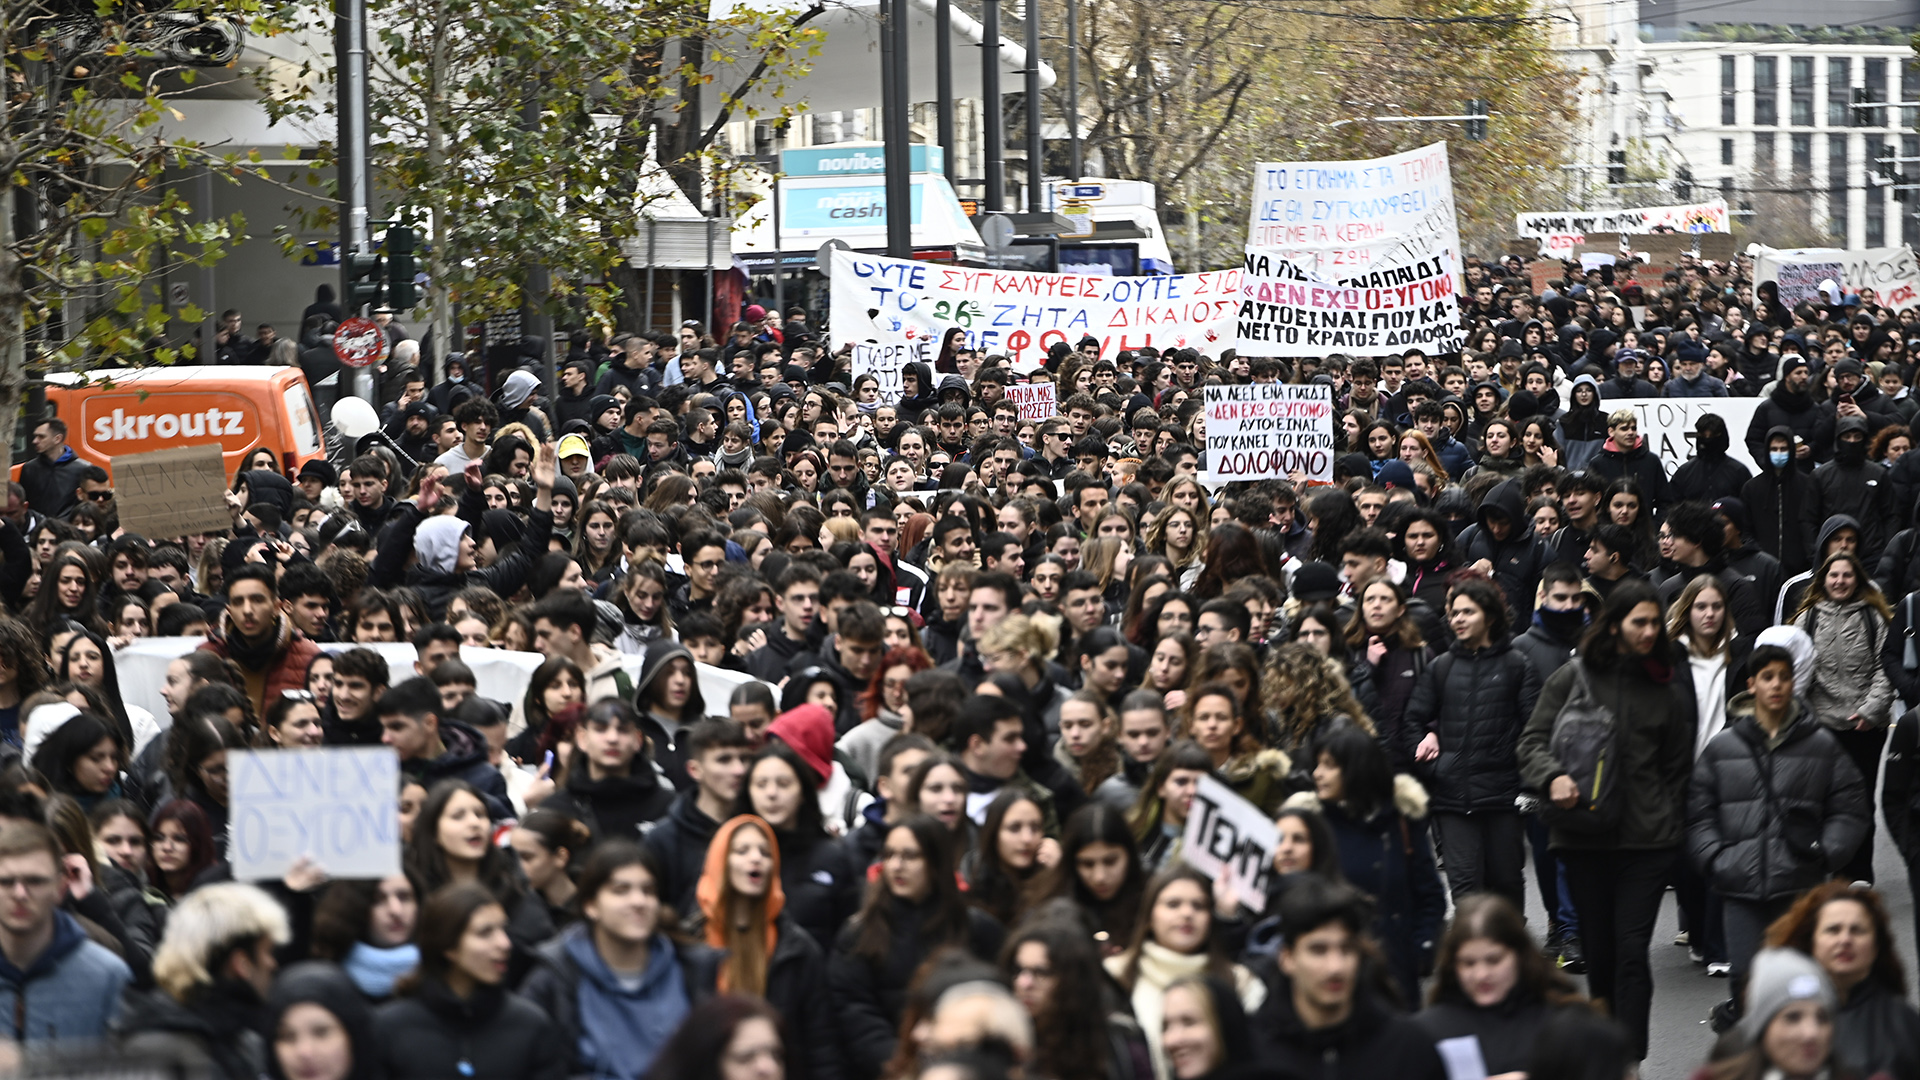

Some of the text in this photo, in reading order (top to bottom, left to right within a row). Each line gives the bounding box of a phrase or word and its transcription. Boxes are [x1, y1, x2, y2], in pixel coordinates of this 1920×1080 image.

[818, 152, 886, 171] novibe
[830, 203, 883, 219] cash
[853, 261, 926, 290] ΟΥΤΕ
[1193, 270, 1244, 295] ΣΙΩ
[871, 287, 918, 312] ΤΟ
[991, 304, 1089, 329] ΖΗΤΑ
[1312, 287, 1359, 310] ΕΧΩ
[1307, 328, 1380, 348] ΚΡΑΤΟΣ
[857, 342, 933, 367] ΠΑΡΕ ΜΕ
[1206, 387, 1223, 402] ΝΑ
[1228, 386, 1257, 401] ΛΕΕΙ
[1263, 385, 1284, 400] ΕΝΑ
[1018, 401, 1055, 419] ΜΩΣΕΤΕ
[1241, 402, 1265, 418] ΕΧΩ
[93, 408, 245, 442] skroutz
[1275, 433, 1292, 448] ΤΟ
[1217, 448, 1327, 476] ΔΟΛΟΦΟΝΟ
[237, 800, 399, 866] ΟΞΥΓΟΝ
[1195, 794, 1270, 890] ΤΕΜΠ
